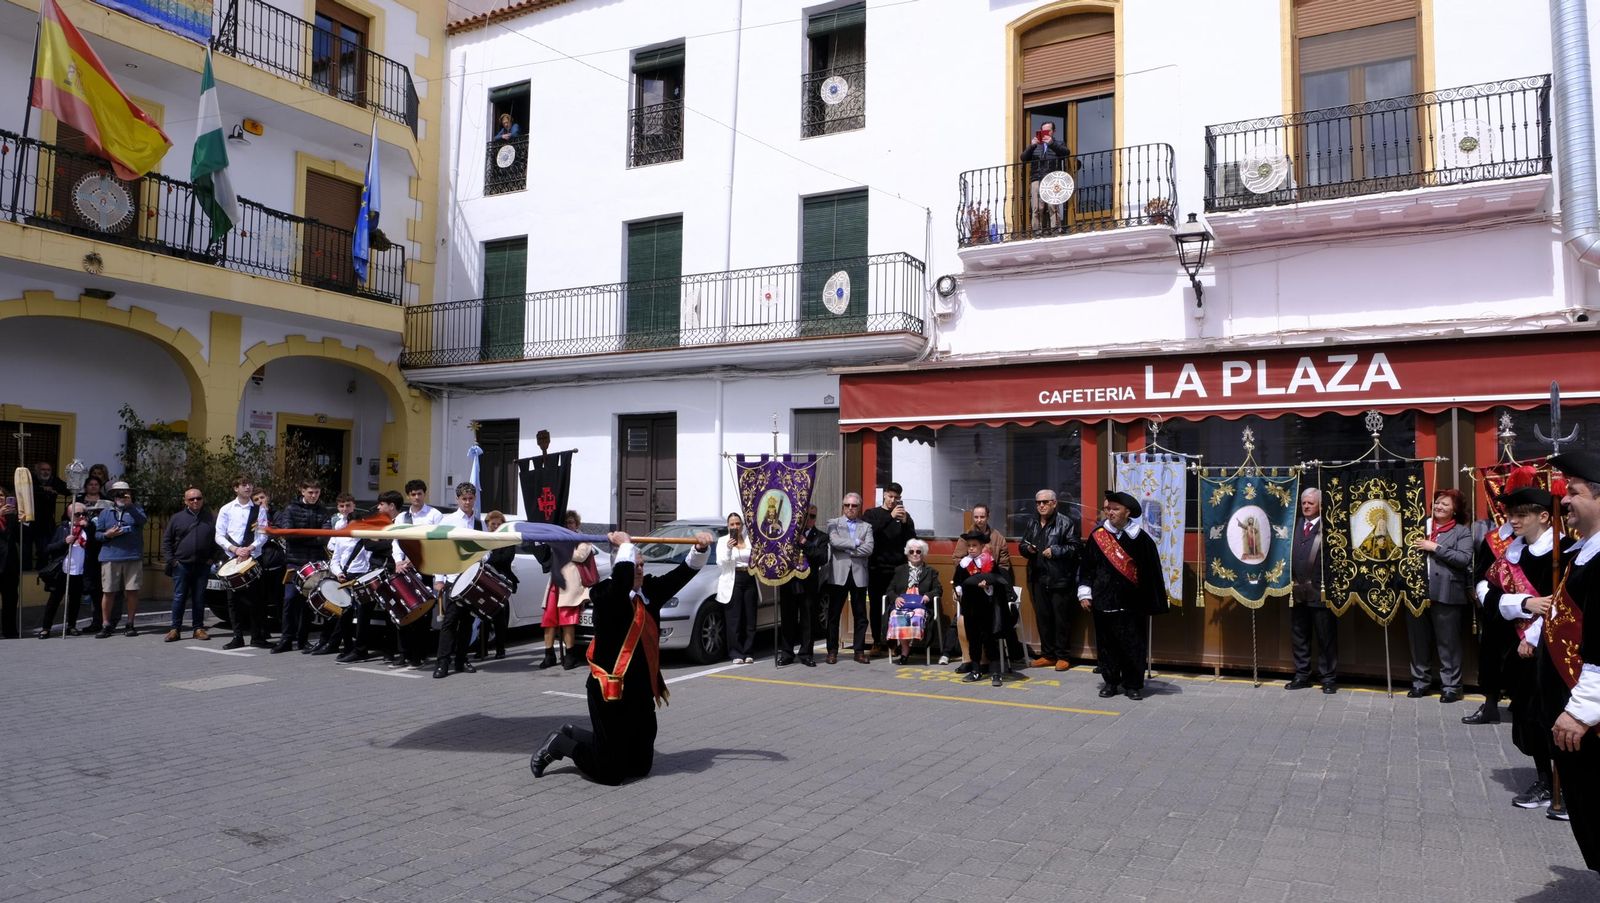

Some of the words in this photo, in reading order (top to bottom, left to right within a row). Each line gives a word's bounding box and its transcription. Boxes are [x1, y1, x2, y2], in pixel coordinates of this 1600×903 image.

[1038, 386, 1136, 404] CAFETERIA
[1144, 362, 1208, 400] LA
[1222, 352, 1402, 397] PLAZA
